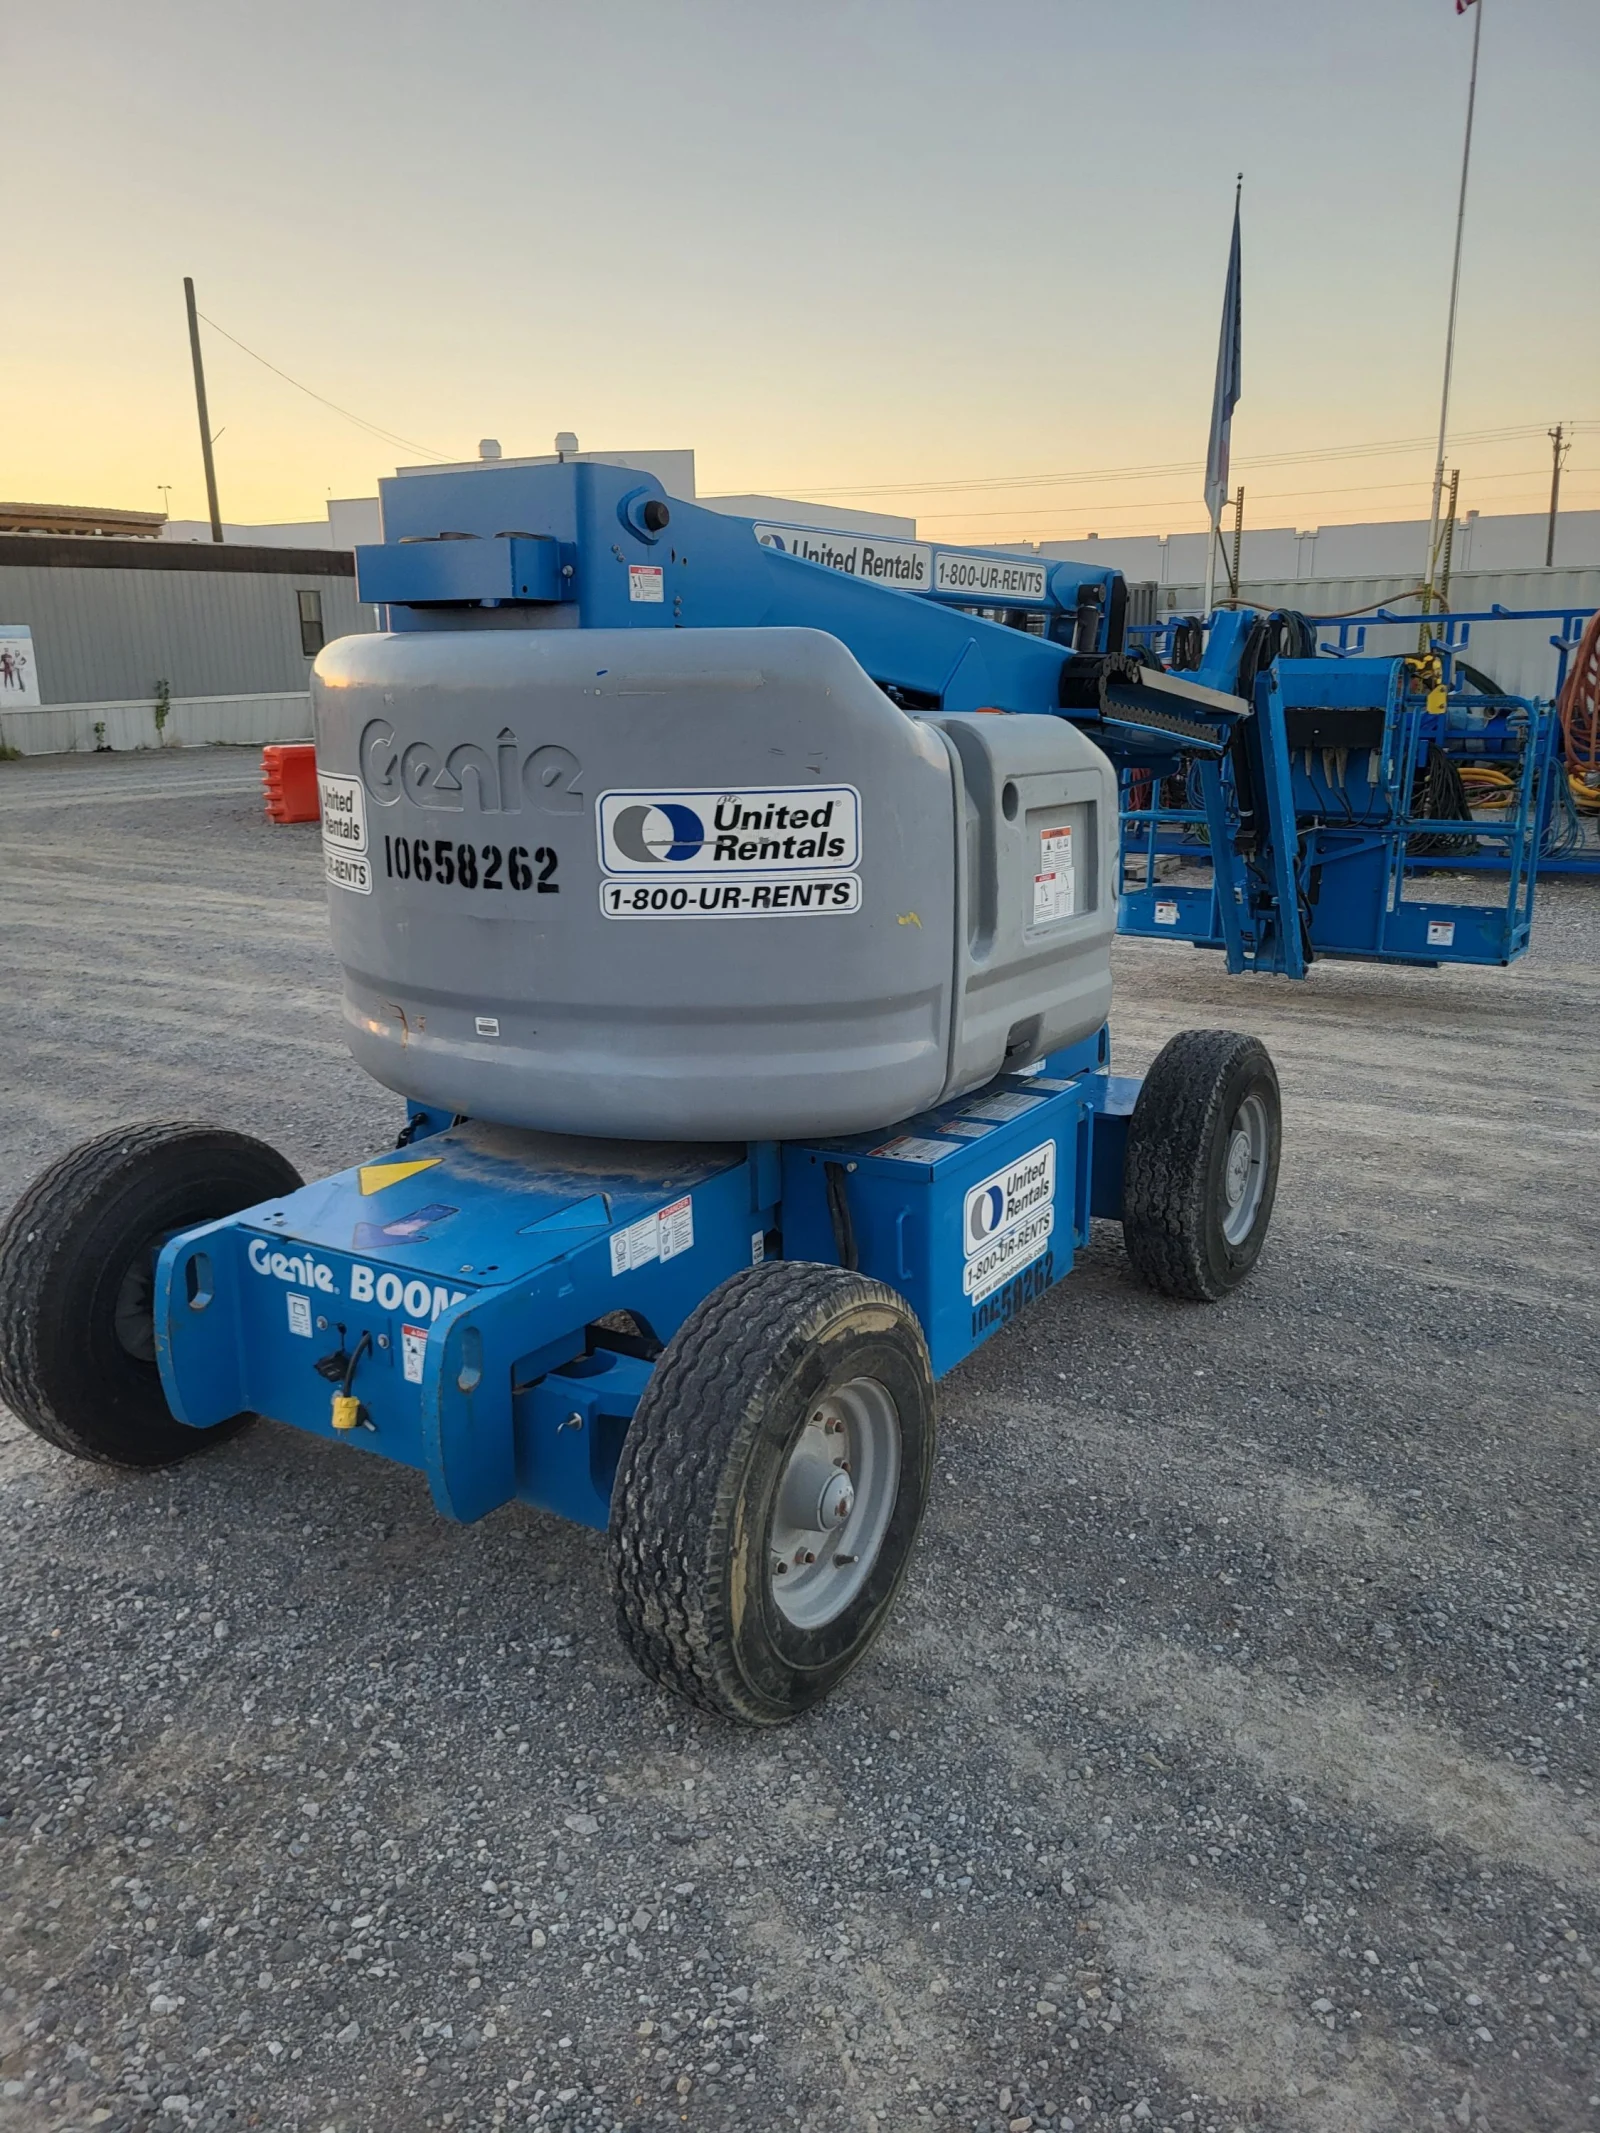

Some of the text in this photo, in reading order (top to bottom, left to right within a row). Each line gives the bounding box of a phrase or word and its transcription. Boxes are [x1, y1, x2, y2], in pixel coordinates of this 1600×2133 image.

[861, 547, 924, 581] Rentals
[939, 562, 1043, 593] 1-800-UR-RENTS
[359, 718, 585, 816] Genie
[322, 785, 354, 813] United
[713, 800, 834, 832] United
[325, 811, 360, 841] Rentals
[713, 832, 846, 861] Rentals
[384, 835, 560, 894] 10658262
[609, 882, 851, 911] 1-800-UR-RENTS
[1006, 1154, 1047, 1197] United
[1005, 1177, 1050, 1221] Rentals
[968, 1212, 1050, 1286] 1-800-UR-RENTS
[248, 1239, 334, 1294] Genie
